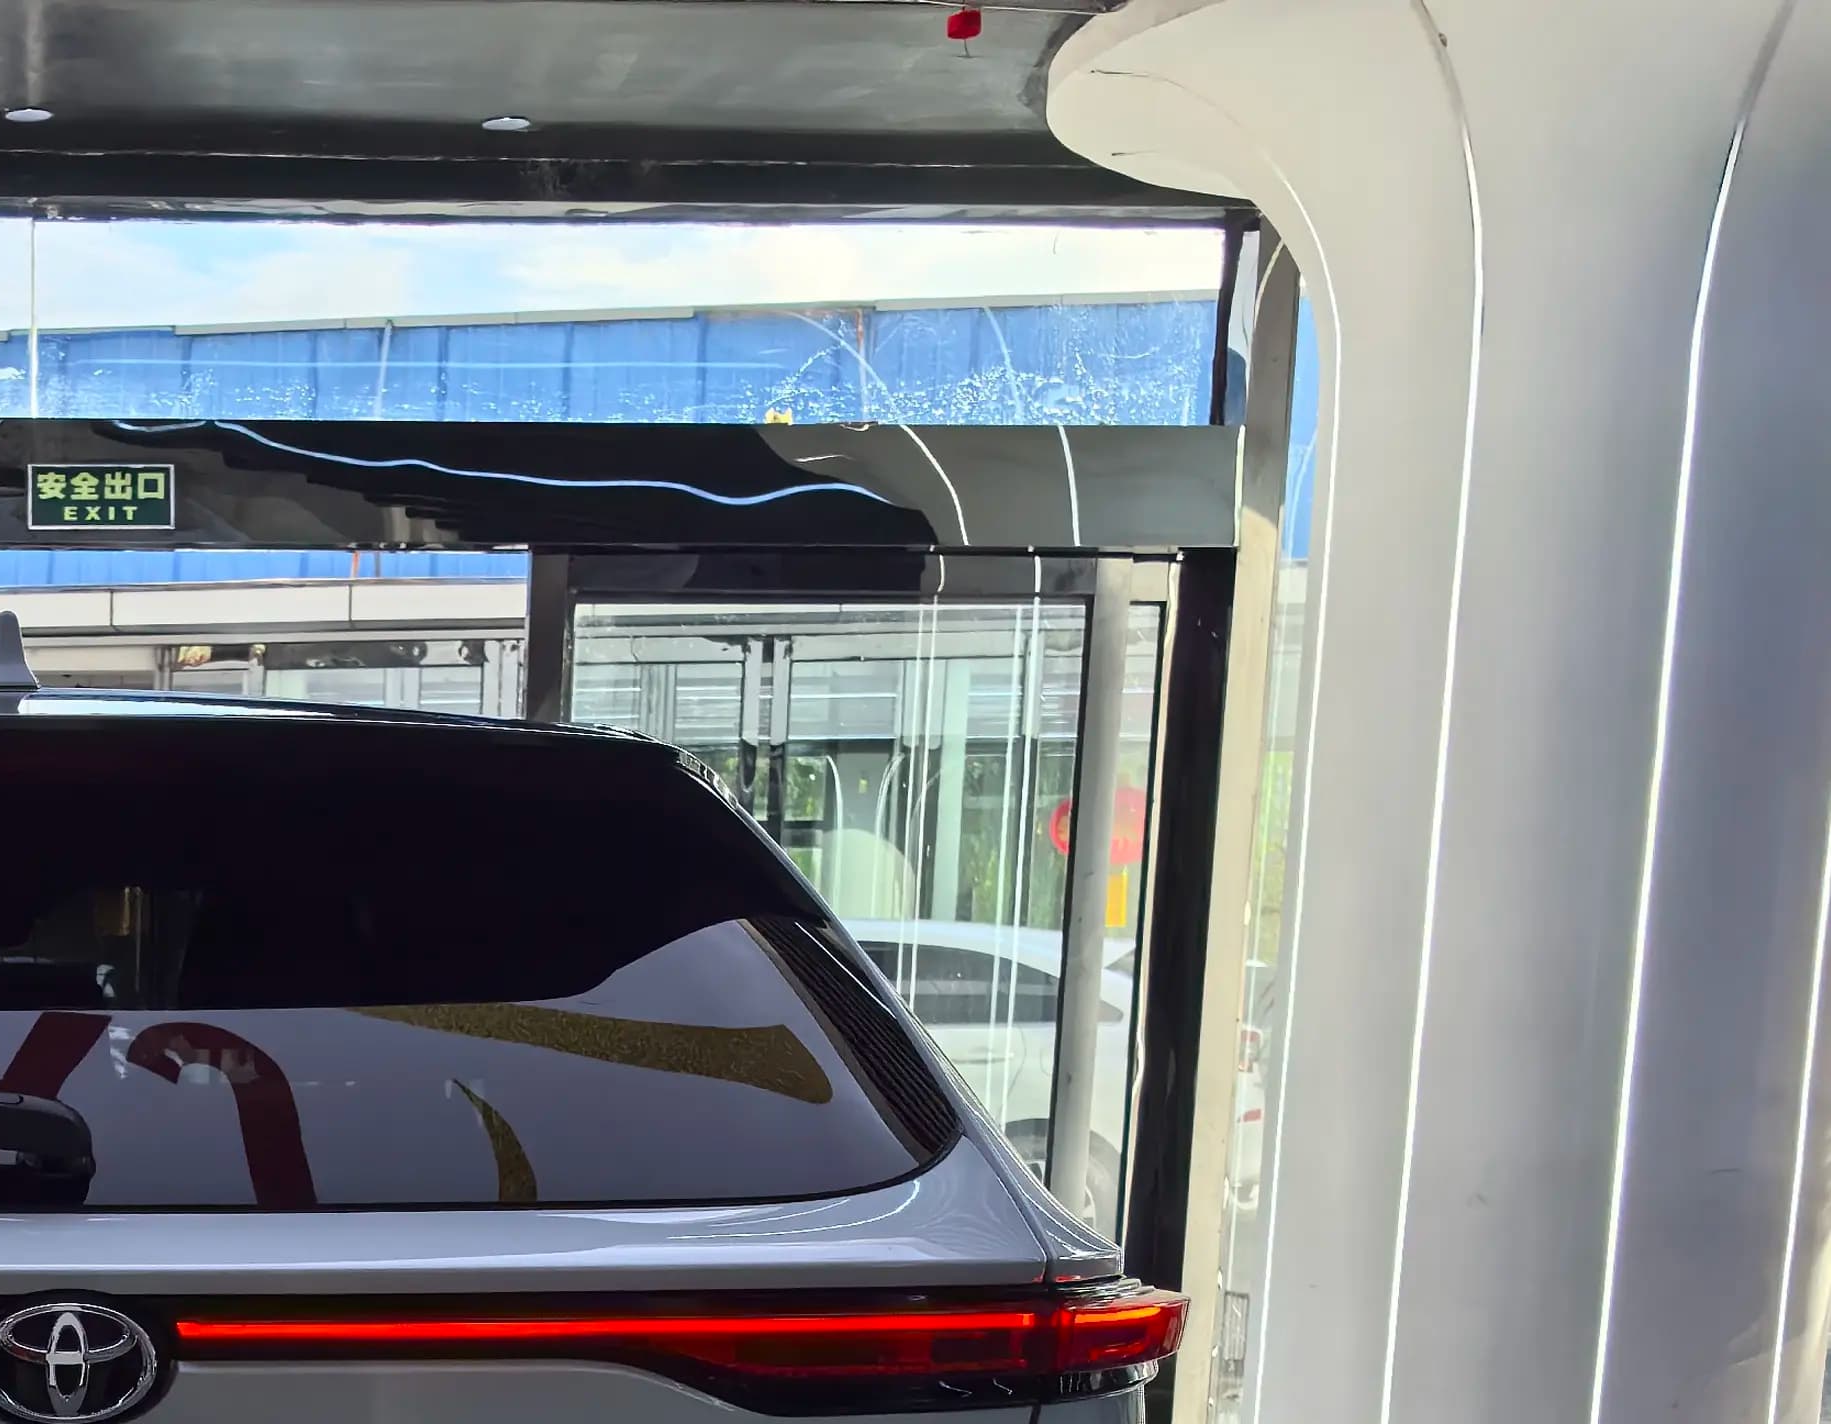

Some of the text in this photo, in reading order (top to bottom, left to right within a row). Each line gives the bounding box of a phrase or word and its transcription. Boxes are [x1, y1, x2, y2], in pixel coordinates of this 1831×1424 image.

[36, 471, 166, 500] 安全出口
[63, 506, 138, 521] EXIT
